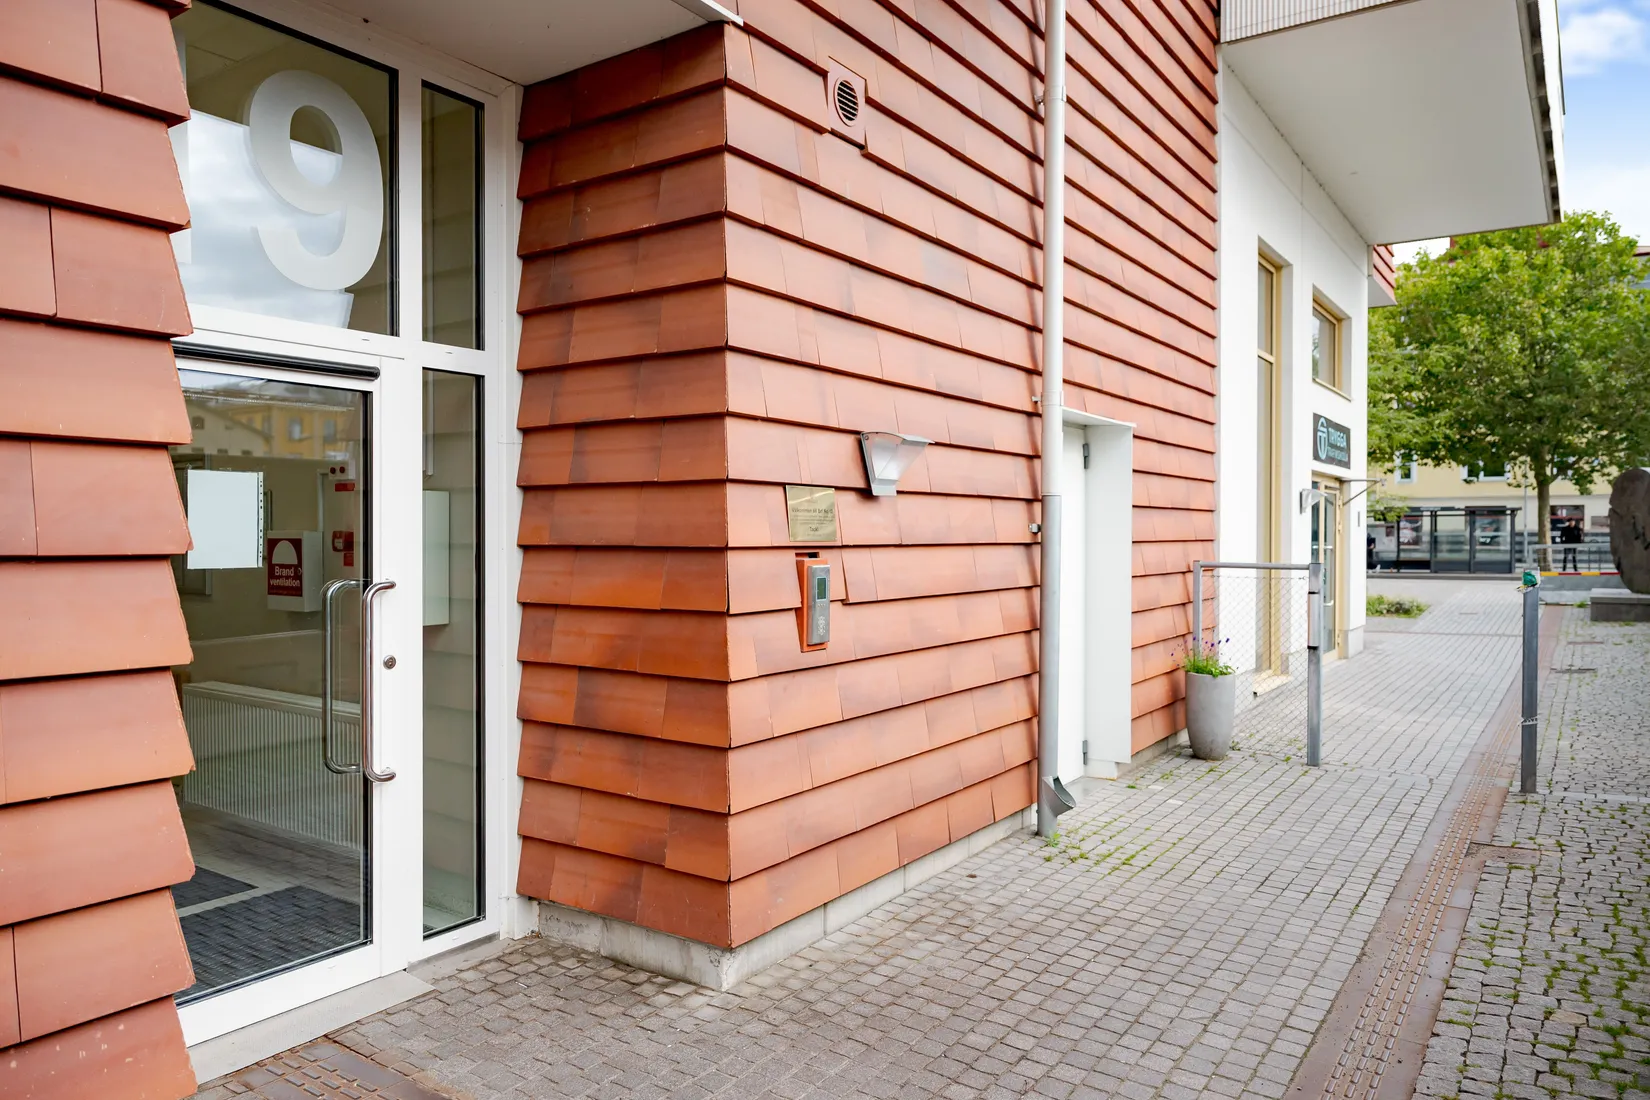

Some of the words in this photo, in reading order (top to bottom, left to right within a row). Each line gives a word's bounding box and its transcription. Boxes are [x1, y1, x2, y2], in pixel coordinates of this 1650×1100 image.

[250, 69, 384, 291] 9
[274, 565, 295, 577] Brand
[269, 577, 301, 587] ventilation
